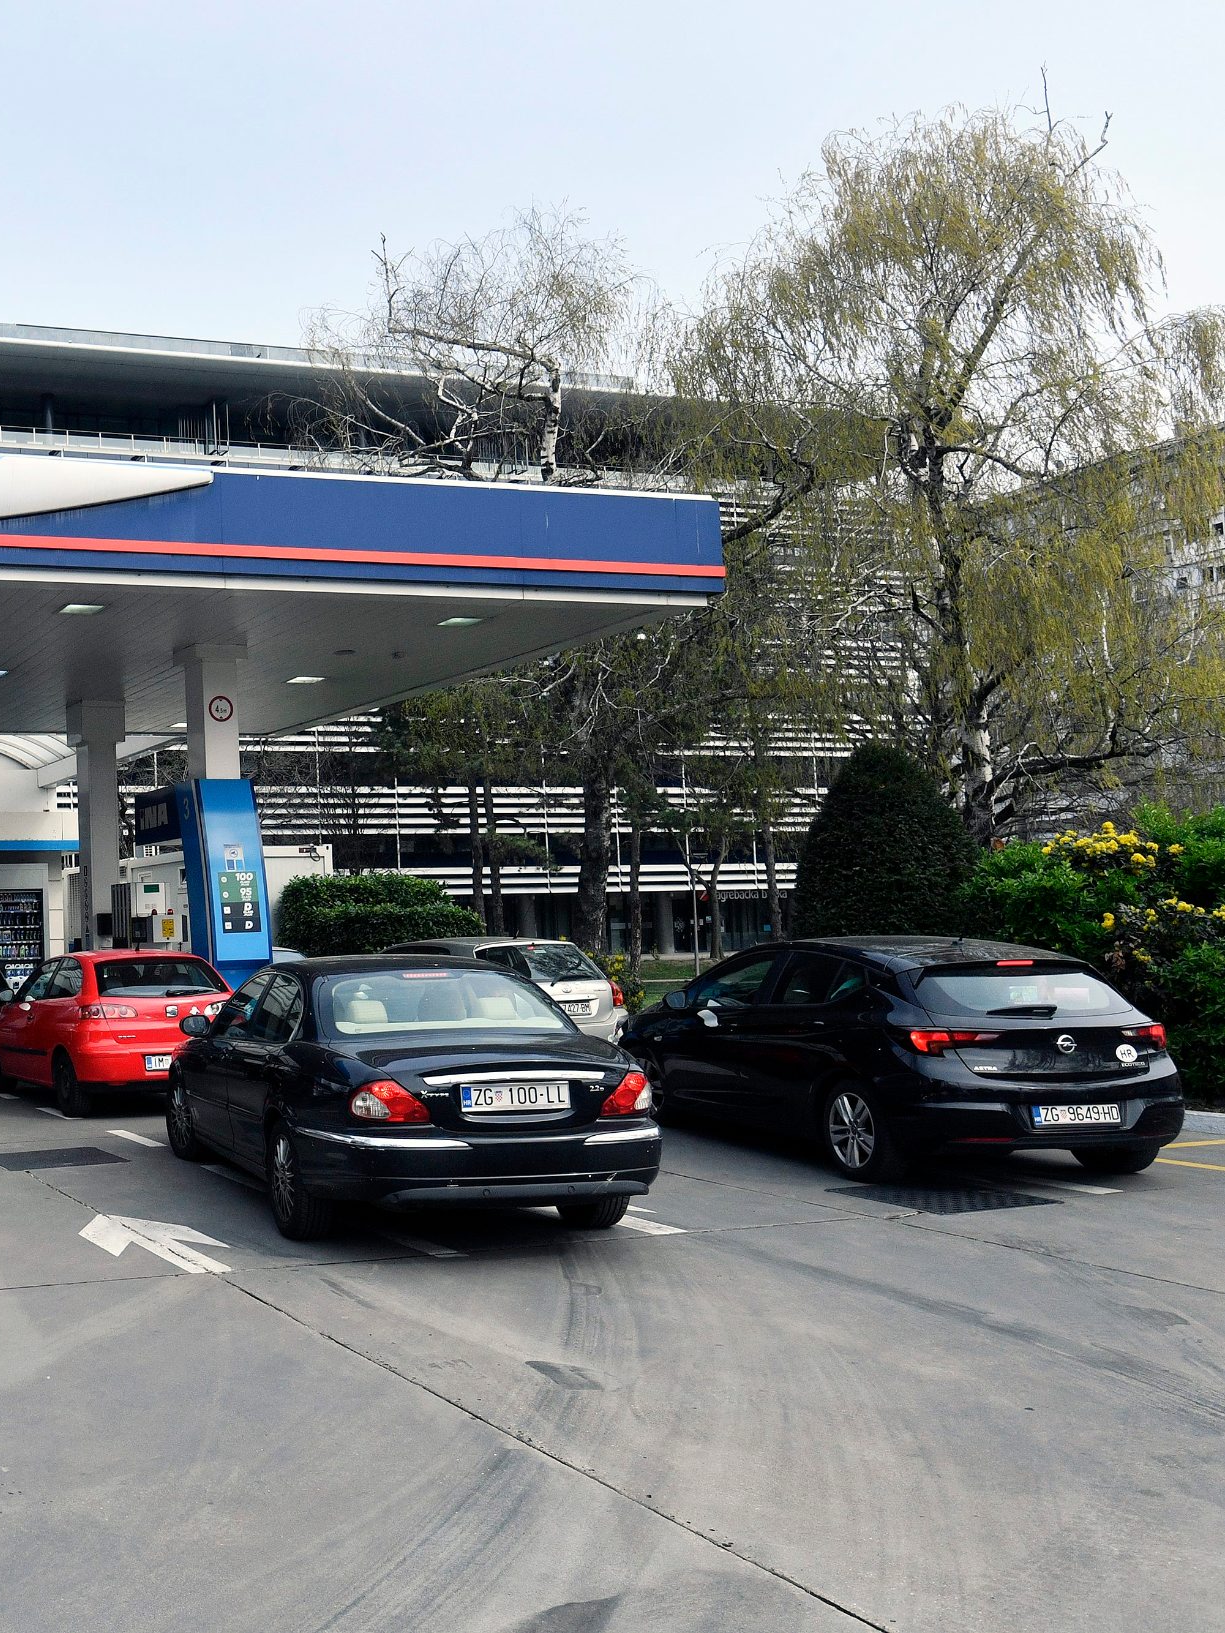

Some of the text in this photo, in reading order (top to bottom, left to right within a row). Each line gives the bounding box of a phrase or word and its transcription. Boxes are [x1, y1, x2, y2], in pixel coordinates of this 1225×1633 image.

[183, 798, 191, 820] 3
[235, 872, 254, 882] 100
[239, 887, 253, 897] 95
[243, 902, 253, 911] D
[245, 920, 254, 930] D
[1120, 1049, 1134, 1058] HR
[473, 1087, 494, 1106] ZG
[509, 1085, 566, 1105] 100-LL
[1041, 1107, 1060, 1122] ZG
[1067, 1105, 1120, 1122] 9649-HD
